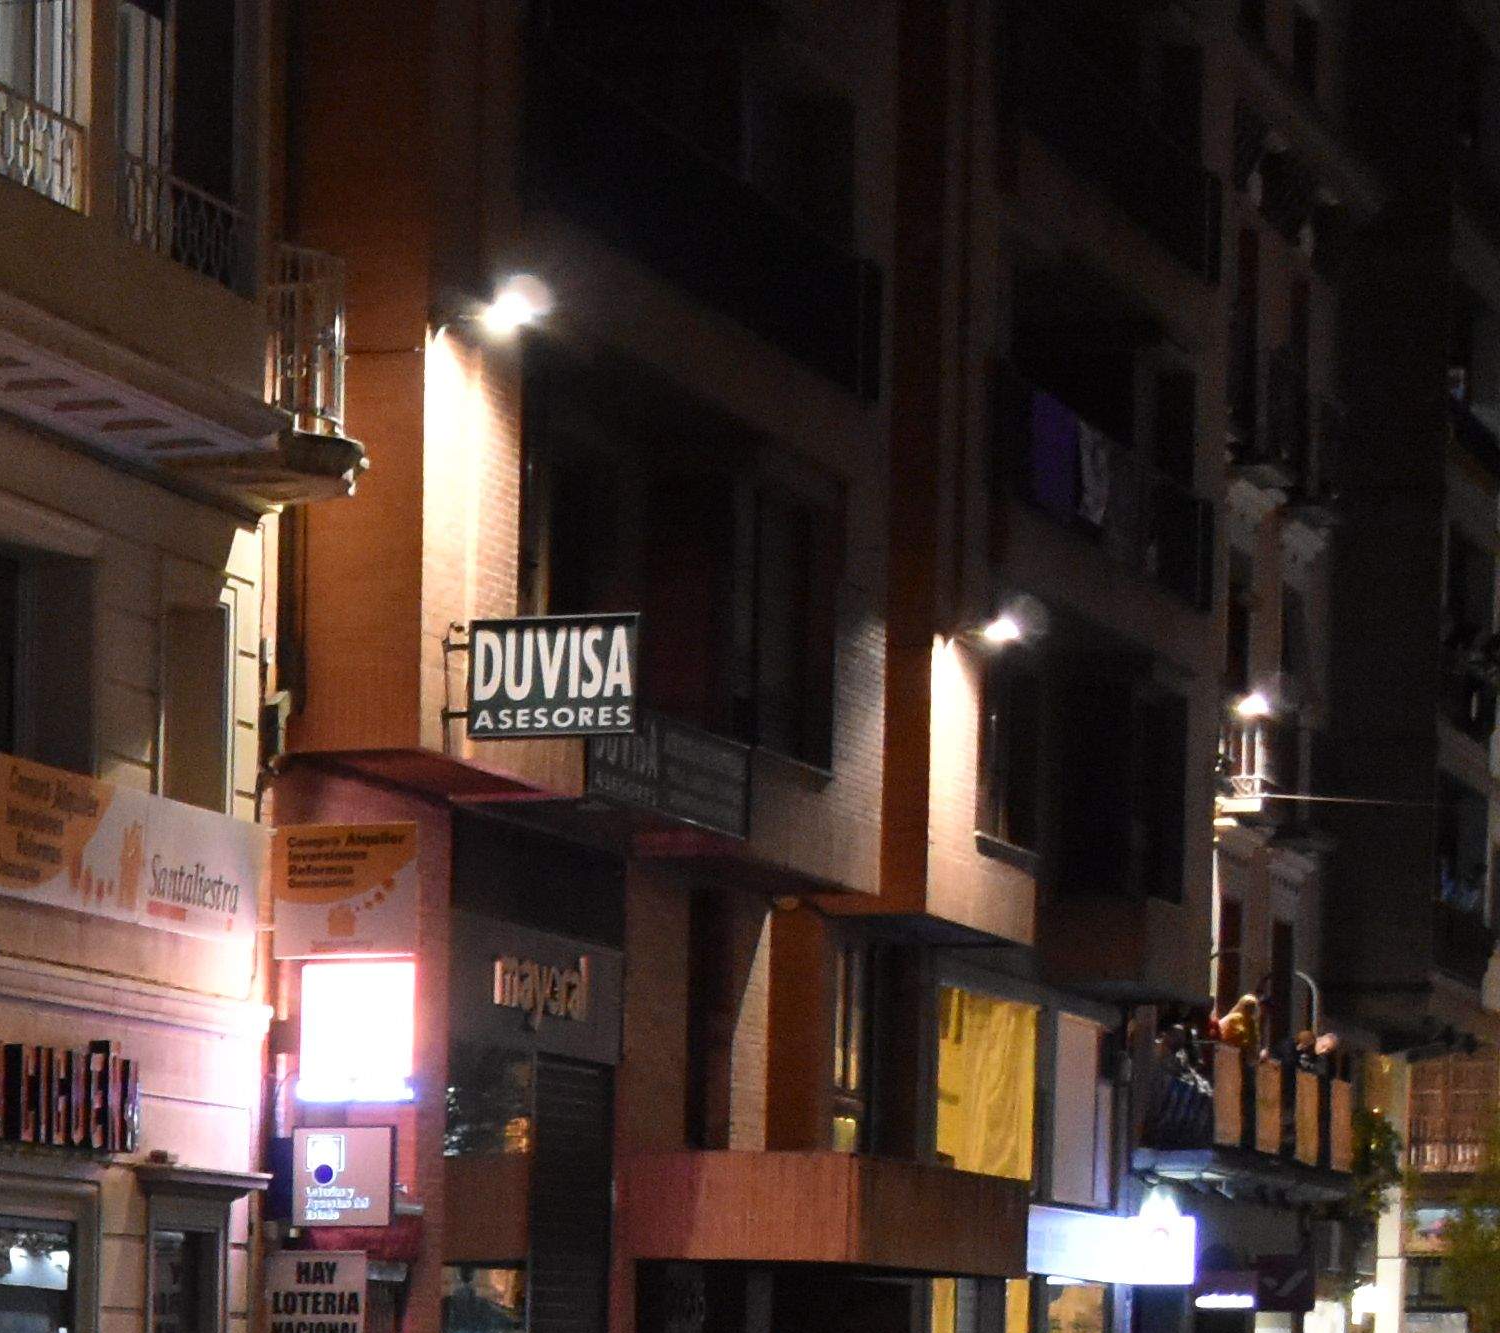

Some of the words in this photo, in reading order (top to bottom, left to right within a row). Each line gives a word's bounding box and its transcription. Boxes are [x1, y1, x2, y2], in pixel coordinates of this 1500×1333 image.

[473, 624, 633, 702] DUVISA
[473, 704, 632, 730] ASESORES
[492, 954, 591, 1032] mayoral
[296, 1262, 337, 1285] HAY
[271, 1291, 360, 1316] LOTERIA
